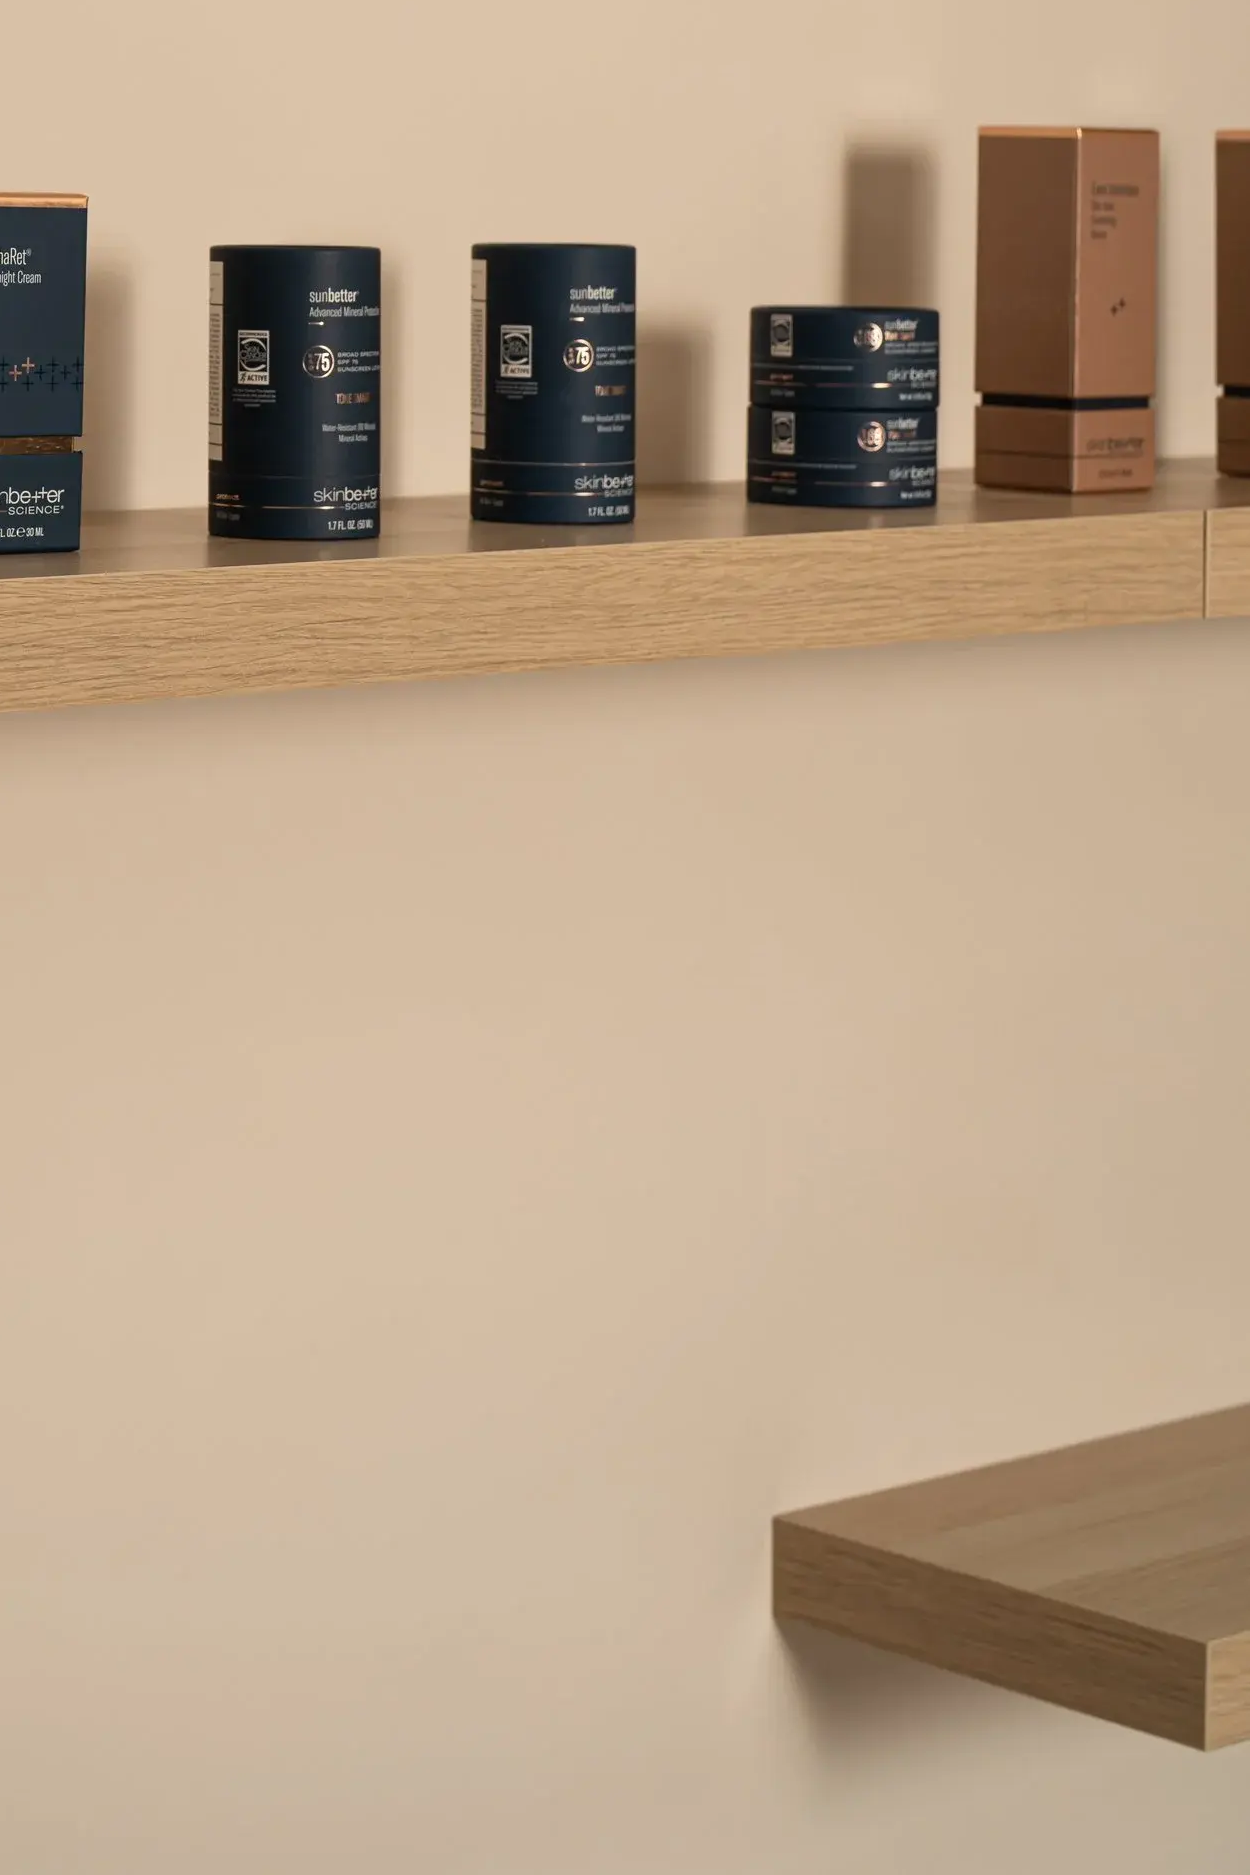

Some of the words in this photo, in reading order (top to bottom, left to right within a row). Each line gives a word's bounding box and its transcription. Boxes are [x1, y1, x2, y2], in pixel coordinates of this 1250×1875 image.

[17, 270, 42, 283] Cream
[309, 306, 342, 317] Advanced
[314, 352, 330, 371] 75
[575, 347, 590, 365] 75
[26, 527, 34, 537] 30
[35, 527, 44, 537] ML
